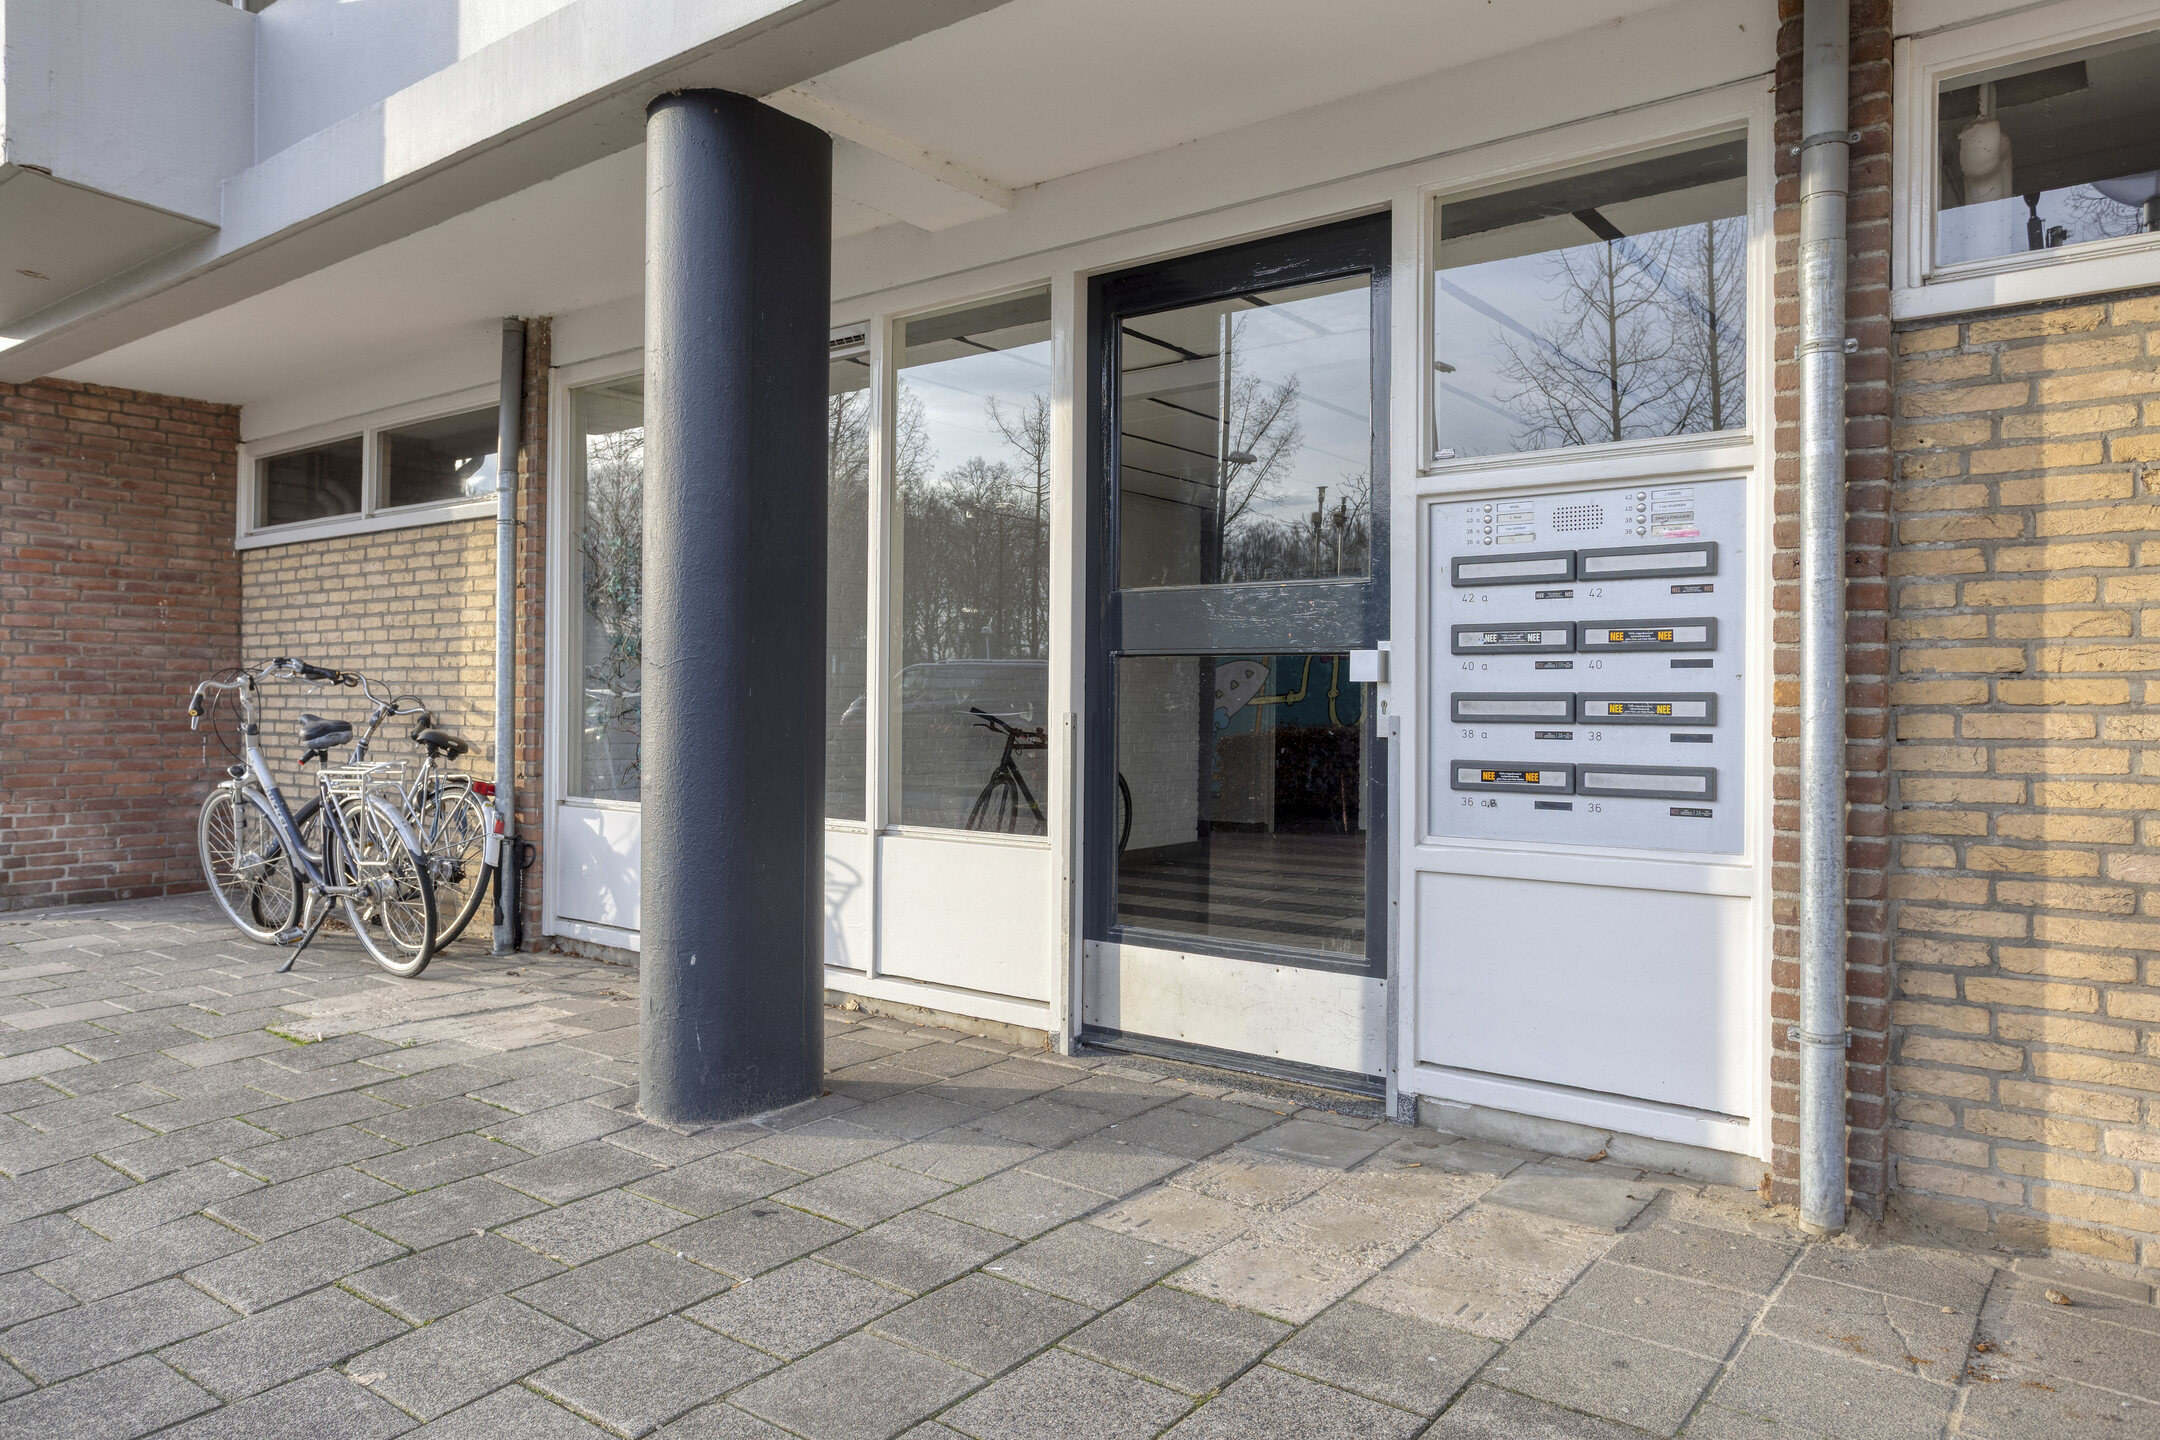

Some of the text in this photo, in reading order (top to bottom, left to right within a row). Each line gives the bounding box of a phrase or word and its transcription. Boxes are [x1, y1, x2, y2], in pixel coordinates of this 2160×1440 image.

[1588, 587, 1603, 598] 42
[1462, 593, 1488, 603] 42 a
[1484, 634, 1498, 643] NEE
[1527, 632, 1541, 642] NEE
[1610, 632, 1624, 641] NEE
[1657, 631, 1672, 640] NEE
[1462, 661, 1488, 671] 40 a
[1588, 659, 1603, 669] 40
[1609, 704, 1623, 713] NEE
[1656, 705, 1671, 714] NEE
[1461, 729, 1488, 739] 38 a
[1588, 731, 1602, 741] 38
[1482, 771, 1496, 781] NEE
[1525, 772, 1539, 782] NEE
[1461, 797, 1474, 807] 36
[1587, 803, 1602, 813] 36
